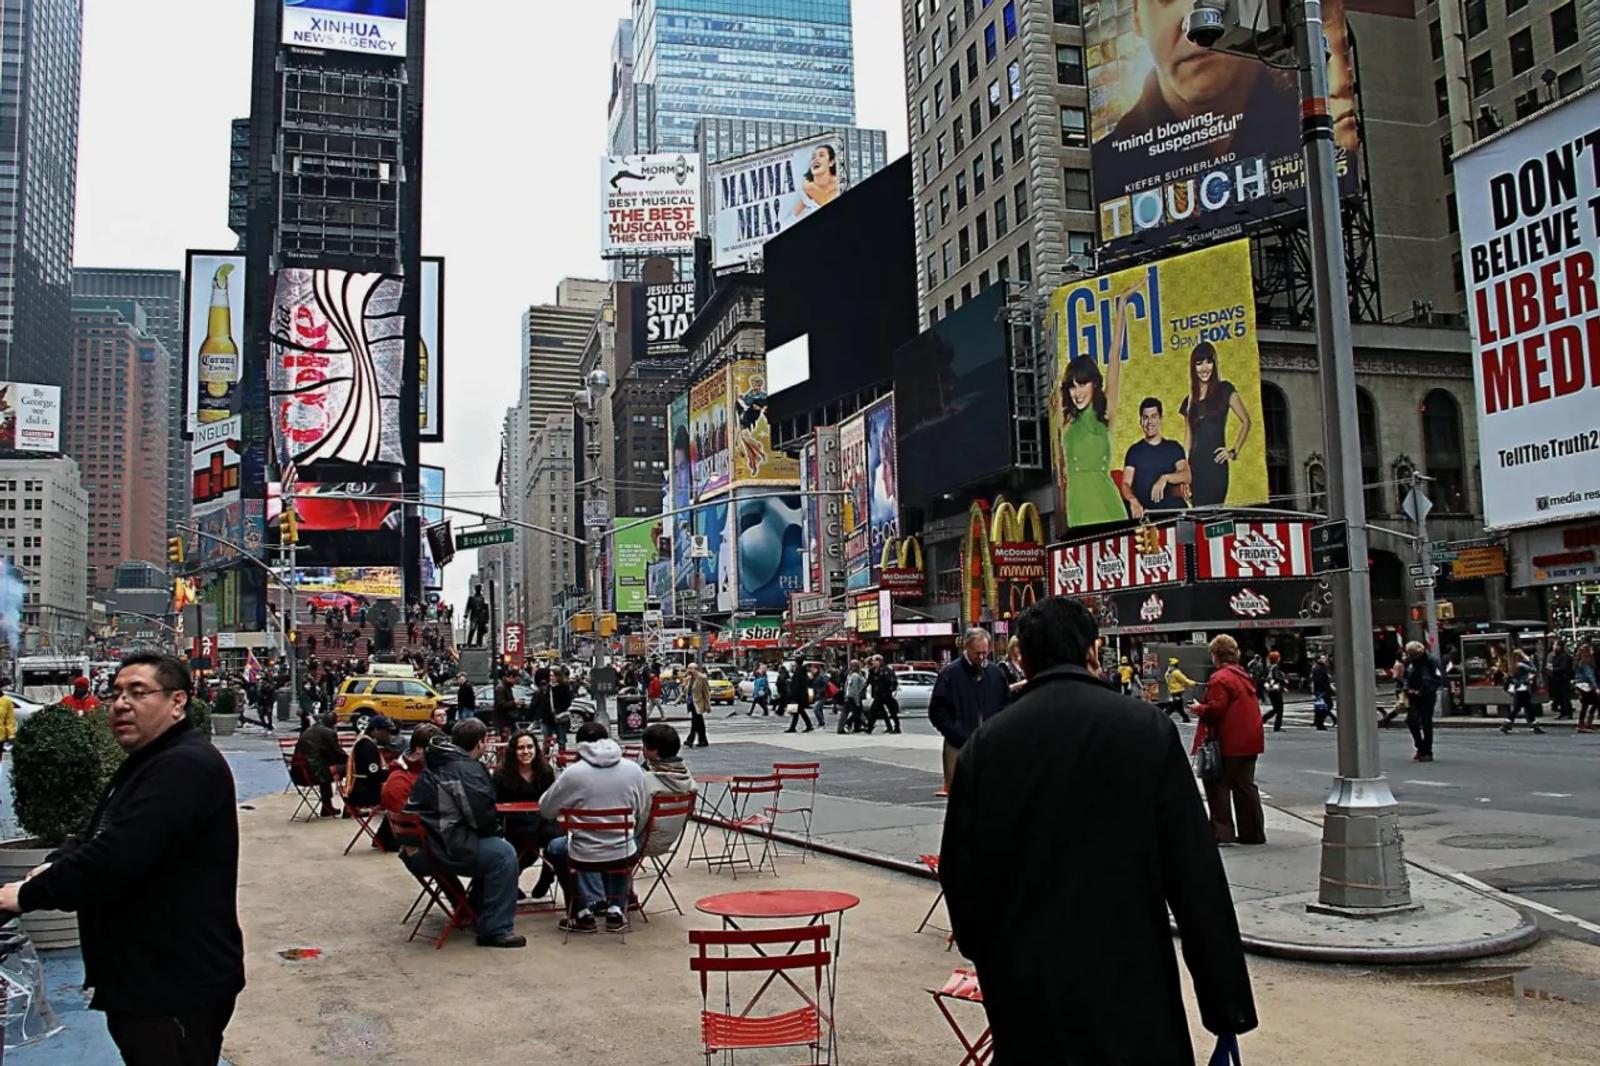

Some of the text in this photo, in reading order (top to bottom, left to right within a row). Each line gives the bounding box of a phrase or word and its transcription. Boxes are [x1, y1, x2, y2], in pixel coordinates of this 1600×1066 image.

[311, 17, 381, 38] XINHUA
[293, 31, 335, 45] NEWS
[340, 36, 396, 51] AGENCY
[1124, 152, 1237, 193] KIEFER SUTHERLAND
[721, 160, 796, 210] MAMMA
[1271, 178, 1299, 195] 9PM
[608, 196, 694, 208] BEST MUSICAL
[1103, 158, 1267, 240] TOUCH
[609, 206, 694, 222] THE BEST
[737, 198, 781, 242] MIA!
[608, 220, 695, 234] MUSICAL OF
[609, 232, 694, 243] THIS CENTURY
[1471, 205, 1582, 284] BELIEVE
[646, 284, 673, 296] JESUS
[1475, 250, 1599, 346] LIBER
[646, 293, 695, 316] SUPE
[1065, 264, 1164, 366] Girl
[1170, 305, 1246, 332] TUESDAYS
[1170, 321, 1247, 351] 9PM FOX 5
[202, 355, 235, 366] Corona
[195, 421, 237, 444] INGLOT
[1498, 429, 1600, 469] TellTheTruth2
[824, 438, 840, 557] PALACE
[1550, 491, 1582, 506] media
[463, 533, 506, 546] Broadway
[995, 548, 1045, 556] McDonald's
[507, 626, 520, 651] tkts
